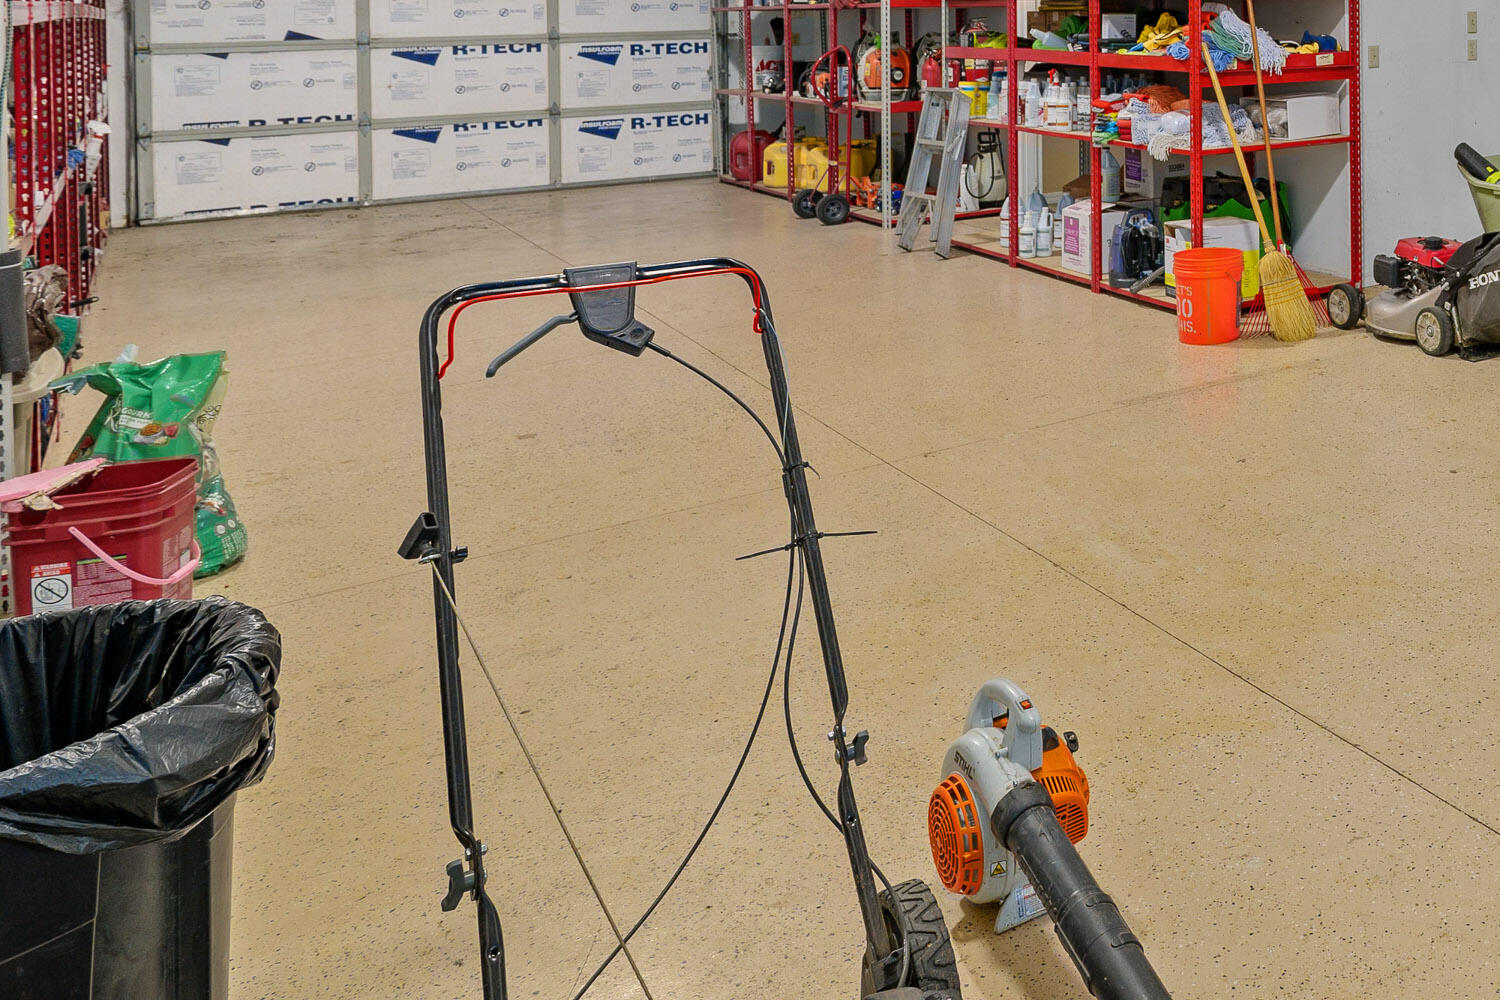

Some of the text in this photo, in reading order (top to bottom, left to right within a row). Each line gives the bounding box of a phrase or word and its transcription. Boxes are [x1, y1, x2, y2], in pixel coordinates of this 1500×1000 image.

[452, 42, 542, 56] R-TECH
[630, 42, 708, 56] R-TECH
[631, 112, 710, 130] R-TECH
[1176, 285, 1192, 297] ET'S
[1178, 320, 1197, 333] HIS.
[953, 751, 975, 780] STIHL
